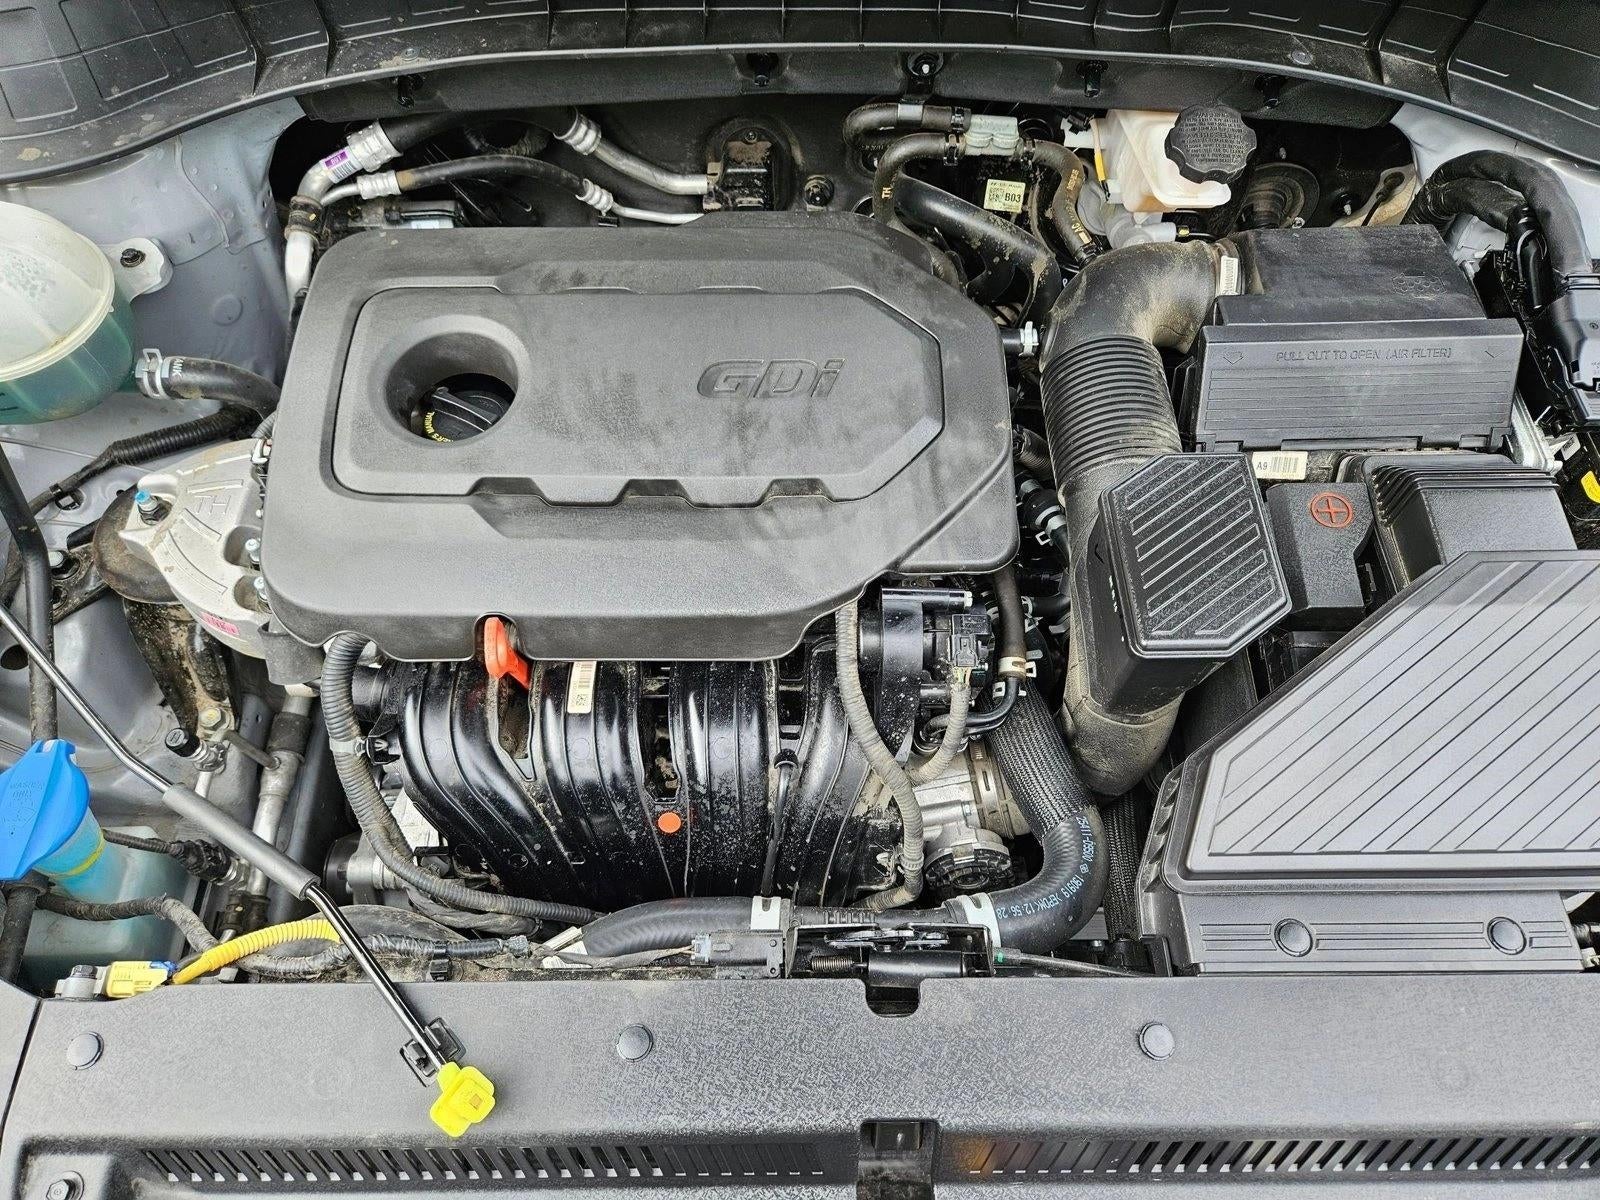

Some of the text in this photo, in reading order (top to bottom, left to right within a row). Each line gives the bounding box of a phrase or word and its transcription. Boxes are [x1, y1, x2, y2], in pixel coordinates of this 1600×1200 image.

[1005, 193, 1021, 203] B03
[1276, 351, 1304, 361] PULL
[1307, 350, 1328, 361] OUT
[1333, 350, 1347, 360] TO
[1350, 350, 1380, 360] OPEN
[697, 358, 847, 399] GDi
[1256, 461, 1268, 471] A9
[1061, 875, 1084, 898] 190919
